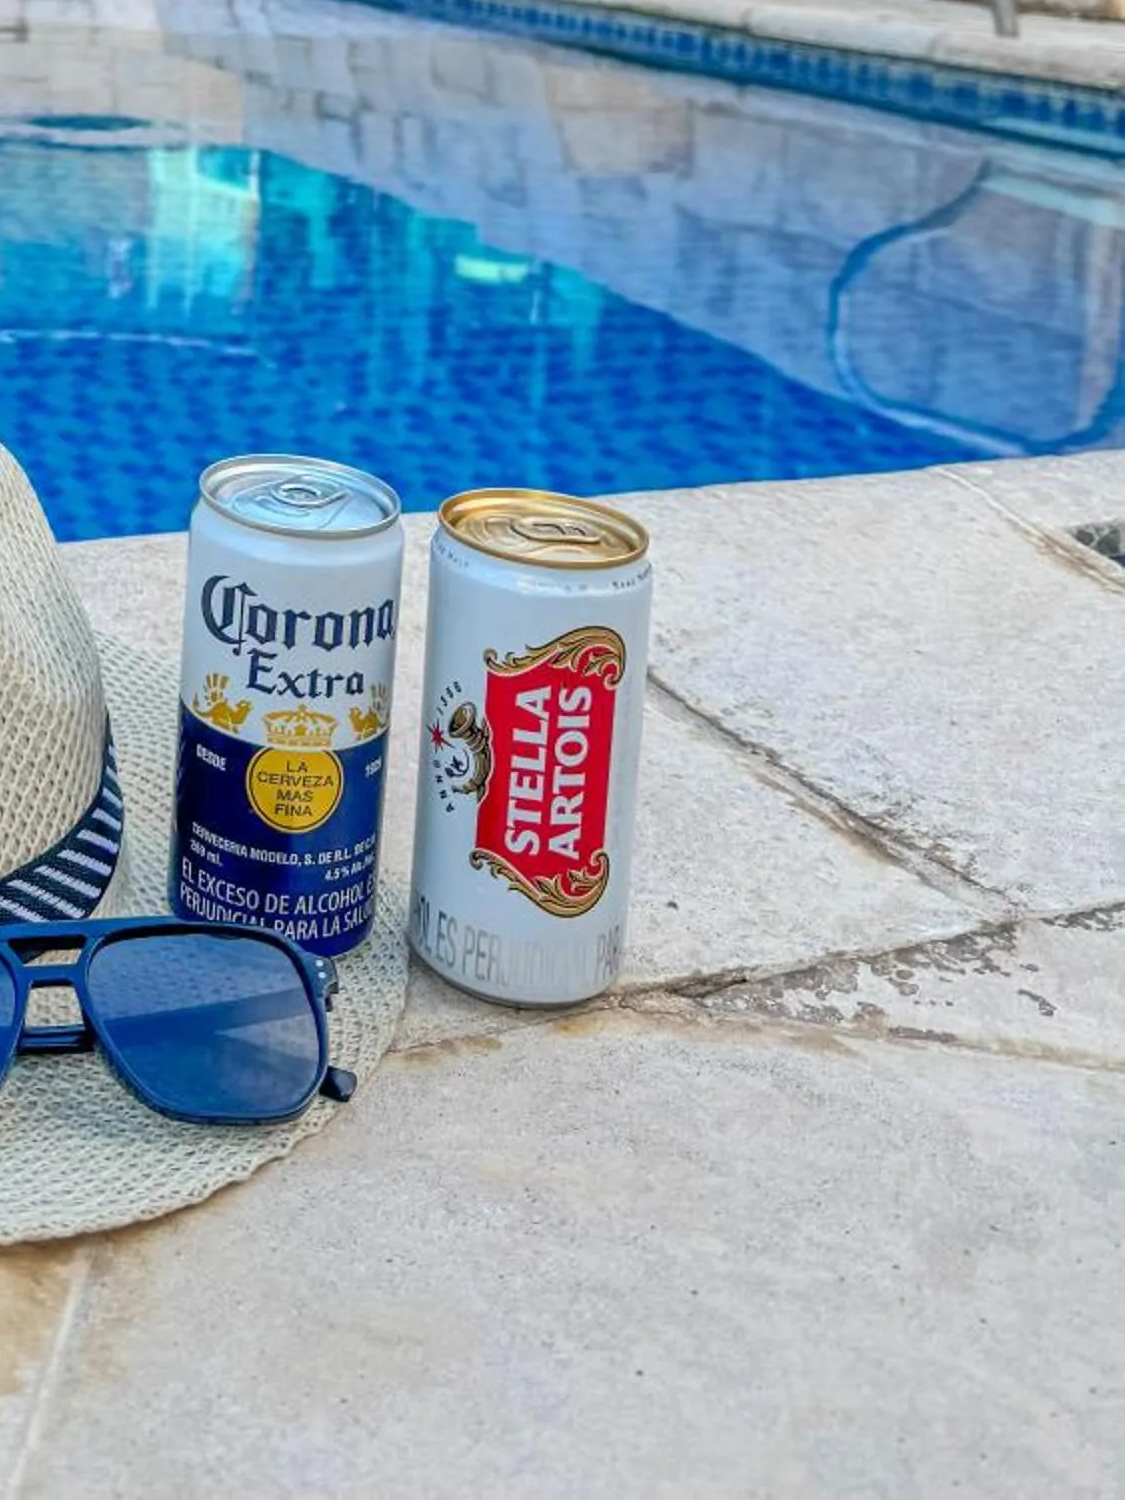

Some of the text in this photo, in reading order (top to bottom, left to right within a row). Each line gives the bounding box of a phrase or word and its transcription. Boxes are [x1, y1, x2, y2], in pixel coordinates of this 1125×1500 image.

[201, 575, 395, 656] Corona
[246, 648, 365, 699] Extra
[257, 771, 335, 788] CERVEZA
[286, 760, 309, 774] LA
[504, 685, 552, 856] STELLA
[548, 686, 593, 861] ARTOIS
[273, 803, 313, 818] FINA
[276, 789, 315, 802] MAS
[182, 856, 194, 884] EL
[198, 869, 260, 911] EXCESO
[265, 893, 290, 915] DE
[294, 880, 364, 915] ALCOHOL
[274, 919, 319, 941] PARA
[322, 915, 342, 938] LA
[435, 909, 458, 967] ES
